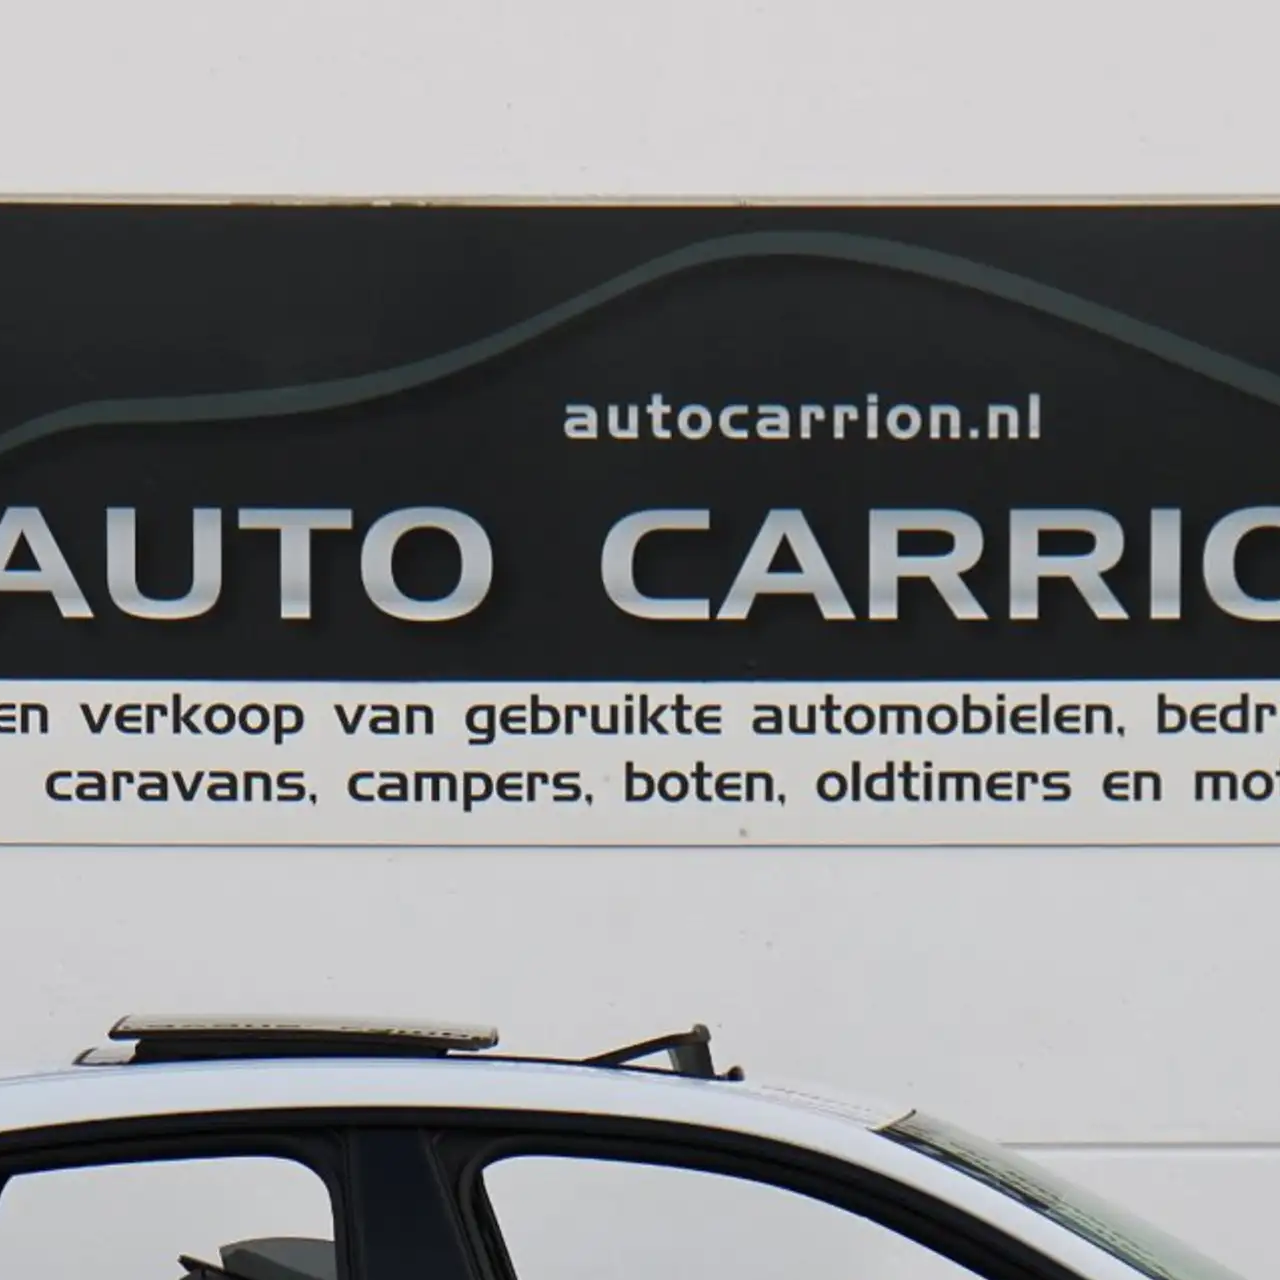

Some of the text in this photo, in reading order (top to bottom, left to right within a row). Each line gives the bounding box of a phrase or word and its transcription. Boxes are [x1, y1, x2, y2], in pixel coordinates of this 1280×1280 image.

[563, 392, 1041, 441] autocarrion.nl
[79, 692, 305, 746] verkoop
[333, 703, 434, 735] van
[465, 693, 722, 746] gebruikte
[752, 693, 1125, 737] automobielen,
[45, 770, 317, 805] caravans,
[347, 771, 593, 813] campers,
[625, 760, 786, 806] boten,
[816, 760, 1072, 803] oldtimers
[1102, 770, 1162, 802] en
